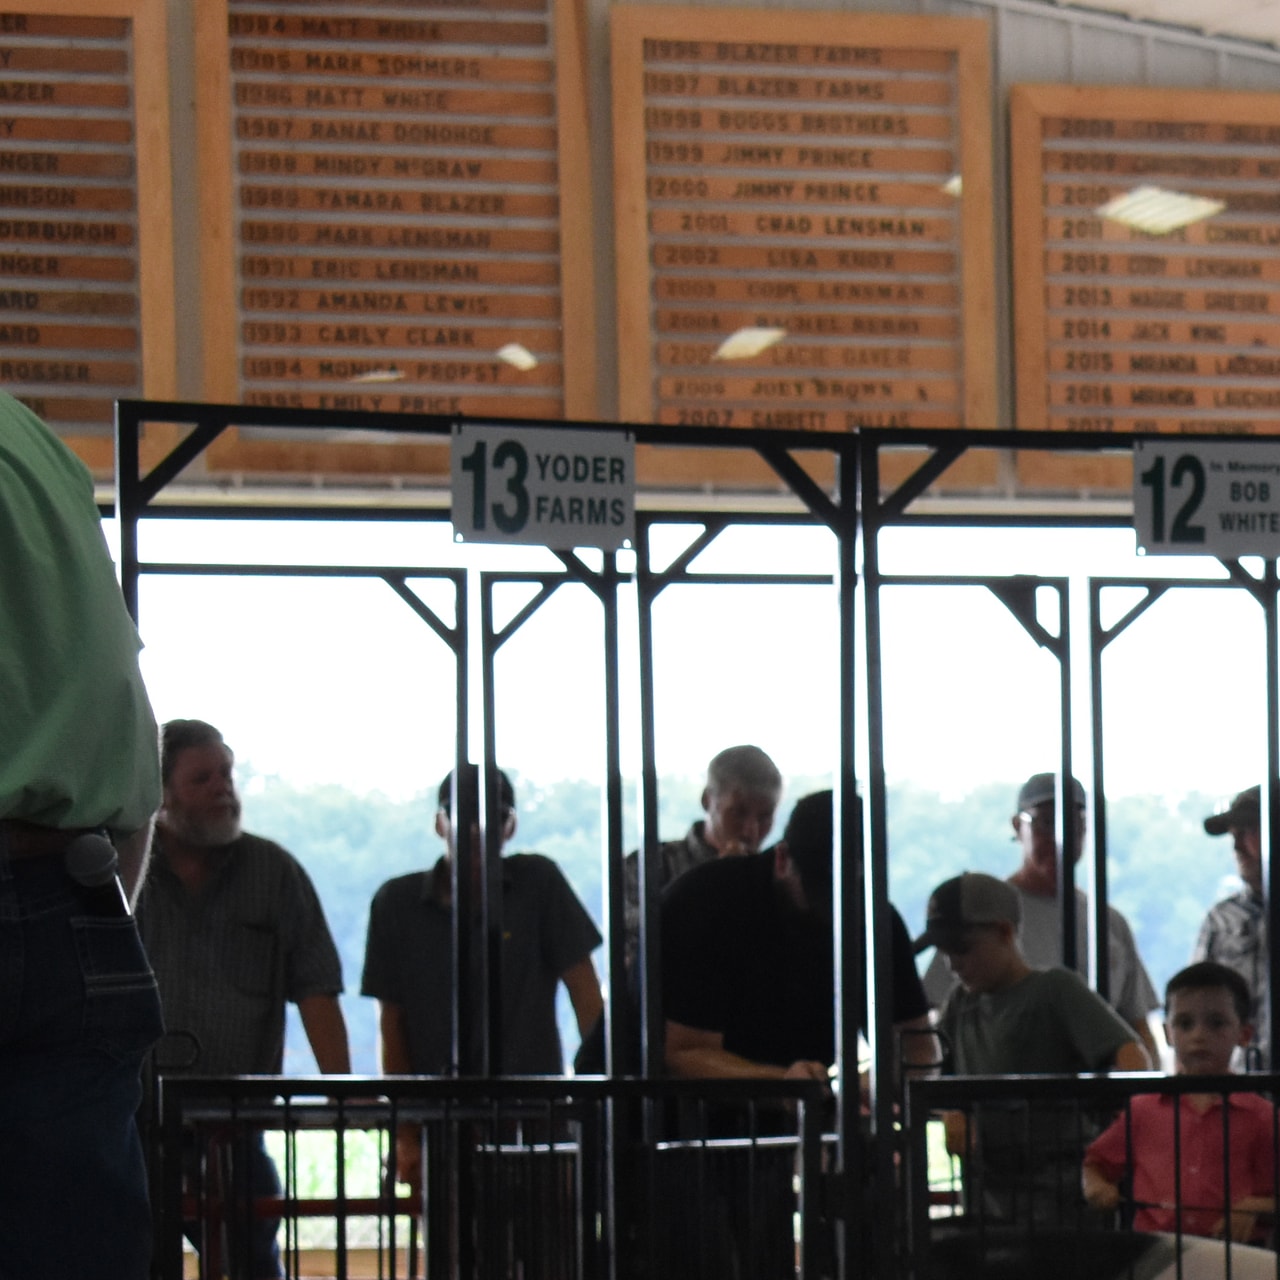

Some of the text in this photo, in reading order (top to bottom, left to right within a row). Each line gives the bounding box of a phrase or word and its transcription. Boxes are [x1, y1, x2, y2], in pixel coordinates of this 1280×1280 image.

[302, 18, 358, 36] MATT
[717, 44, 798, 61] BLAZER
[814, 46, 881, 64] FARMS
[306, 53, 361, 71] MARK
[378, 57, 480, 79] SOMMERS
[650, 75, 884, 99] 1997 BLAZER FARMS
[306, 88, 363, 107] MATT
[383, 90, 448, 110] WHITE
[240, 118, 292, 137] 1987
[312, 122, 380, 141] RANAE
[801, 115, 908, 135] BROTHERS
[243, 154, 297, 171] 1988
[315, 156, 380, 174] MINDY
[653, 147, 873, 167] 1999 JIMMY PRINCE
[656, 180, 878, 201] 2000 JIMMY PRINCE
[317, 191, 403, 209] TAMARA
[421, 193, 505, 212] BLAZER
[681, 215, 924, 235] 2001 CHAD LENSMAN
[1063, 221, 1102, 238] 2011
[316, 226, 372, 245] MARK
[388, 228, 490, 247] LENSMAN
[666, 248, 719, 264] 2002
[768, 251, 817, 267] LISA
[1063, 253, 1110, 271] 2012
[245, 258, 478, 280] 1991 ERIC LENSMAN
[819, 283, 924, 298] LENSMAN
[1064, 287, 1111, 305] 2013
[248, 293, 488, 313] 1992 AMANDA LEWIS
[248, 326, 474, 345] 1993 CARLY CLARK
[1063, 322, 1110, 338] 2014
[1131, 324, 1170, 340] JACK
[250, 360, 301, 377] 1994
[417, 364, 499, 382] PROPST
[1065, 353, 1113, 370] 2015
[1130, 355, 1198, 373] MIRANDA
[752, 381, 803, 396] JOEY
[817, 381, 891, 398] BROWN
[1066, 386, 1113, 403] 2016
[1131, 389, 1195, 406] MIRANDA
[320, 396, 384, 412] EMILY
[401, 397, 459, 414] PRICE
[678, 410, 733, 426] 2007
[536, 454, 625, 484] YODER
[1210, 461, 1223, 472] In
[1228, 461, 1280, 475] Memory
[461, 439, 530, 535] 13
[1230, 481, 1270, 502] BOB
[1141, 453, 1206, 543] 12
[536, 496, 625, 526] FARMS
[1219, 511, 1280, 533] WHITE
